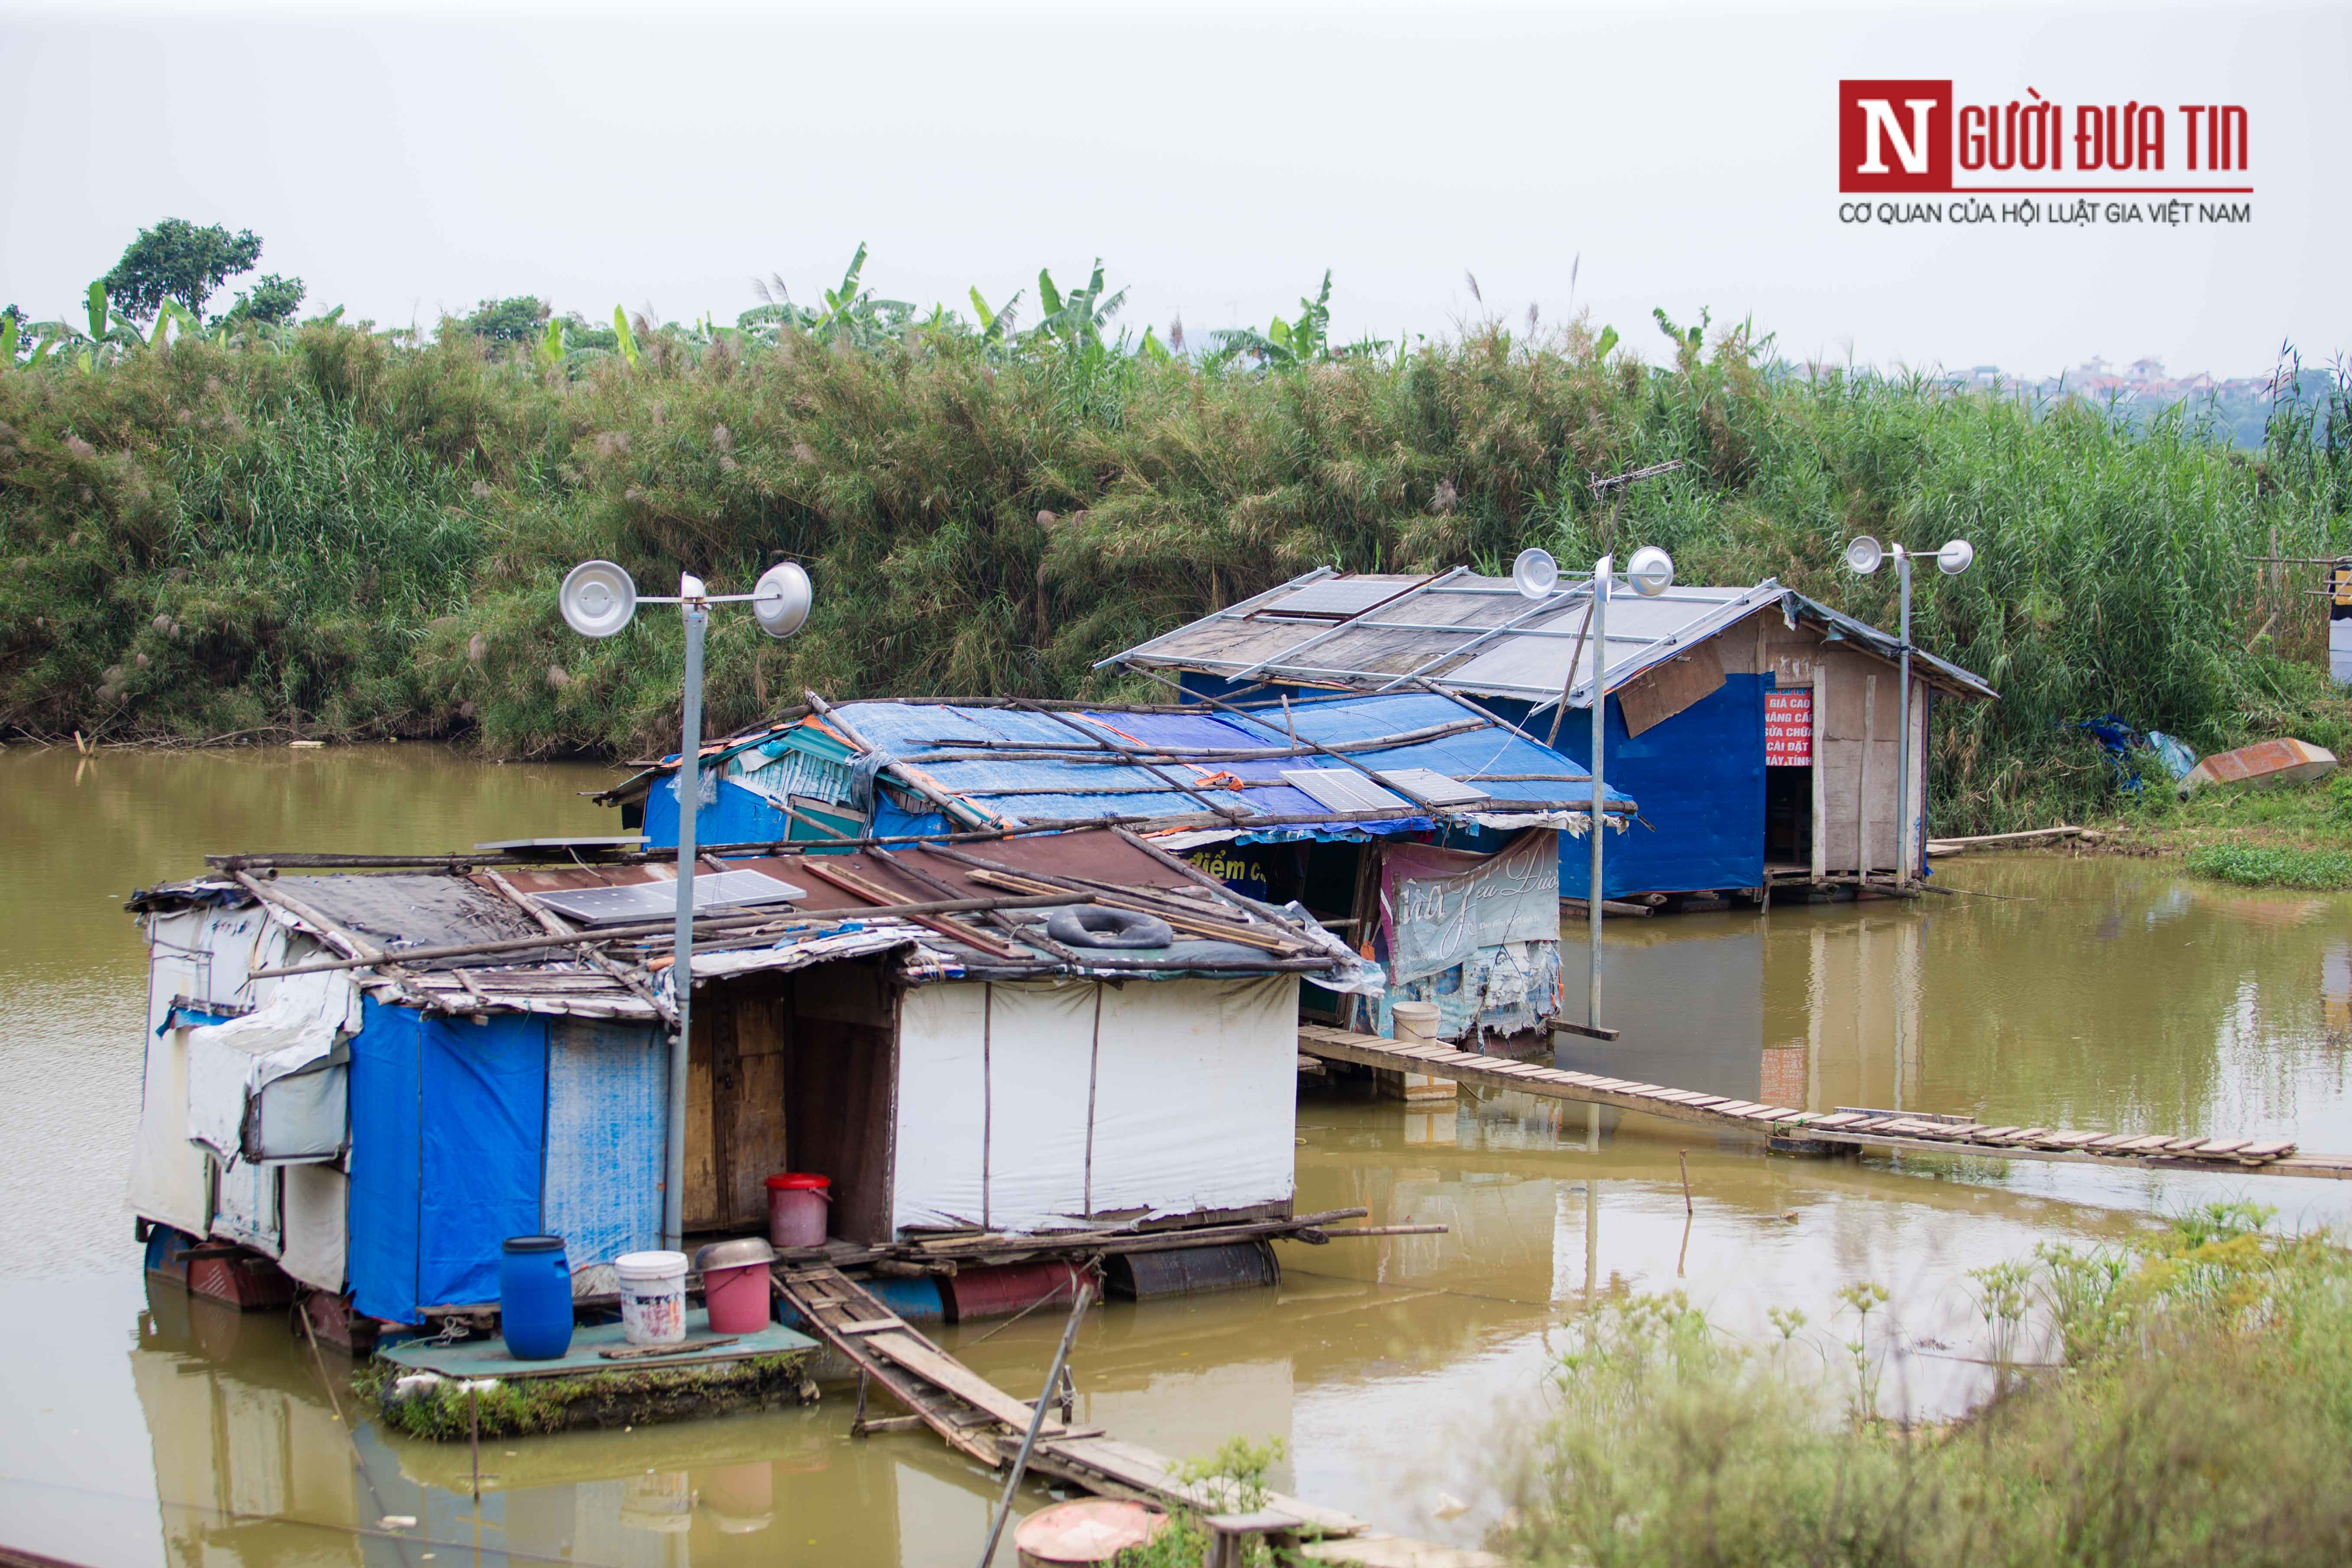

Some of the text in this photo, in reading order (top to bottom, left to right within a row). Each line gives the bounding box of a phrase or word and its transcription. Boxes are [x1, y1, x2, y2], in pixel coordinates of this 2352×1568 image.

[1770, 697, 1810, 708] GIÁ CAO
[1767, 740, 1808, 753] CÀI ĐẶT
[1787, 755, 1812, 766] TÍNH
[1189, 850, 1245, 880] điểm
